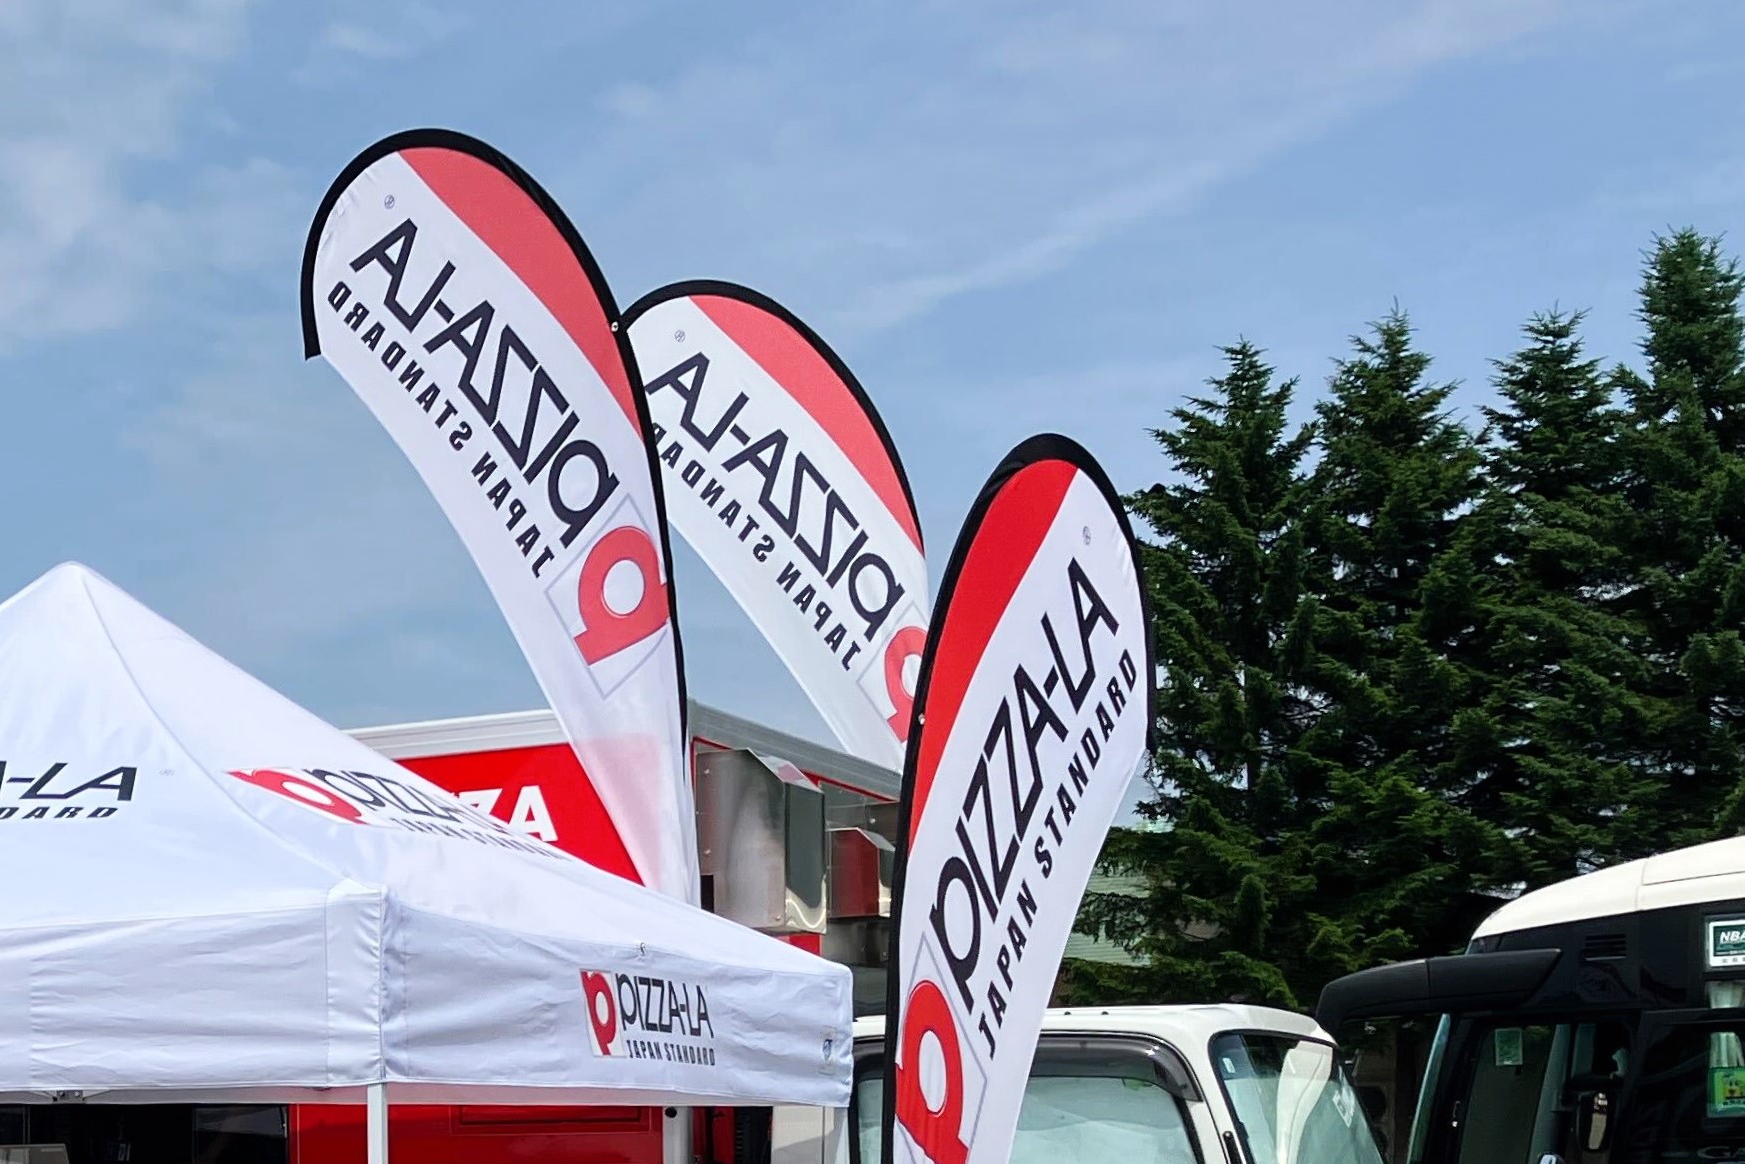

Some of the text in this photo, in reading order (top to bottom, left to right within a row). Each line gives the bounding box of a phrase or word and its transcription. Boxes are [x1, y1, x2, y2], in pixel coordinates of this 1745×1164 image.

[930, 556, 1118, 1016] PIZZA-LA
[979, 647, 1139, 1059] JAPAN STANDARD
[615, 973, 715, 1039] PIZZA-LA
[626, 1039, 716, 1067] JAPAN STANDARD
